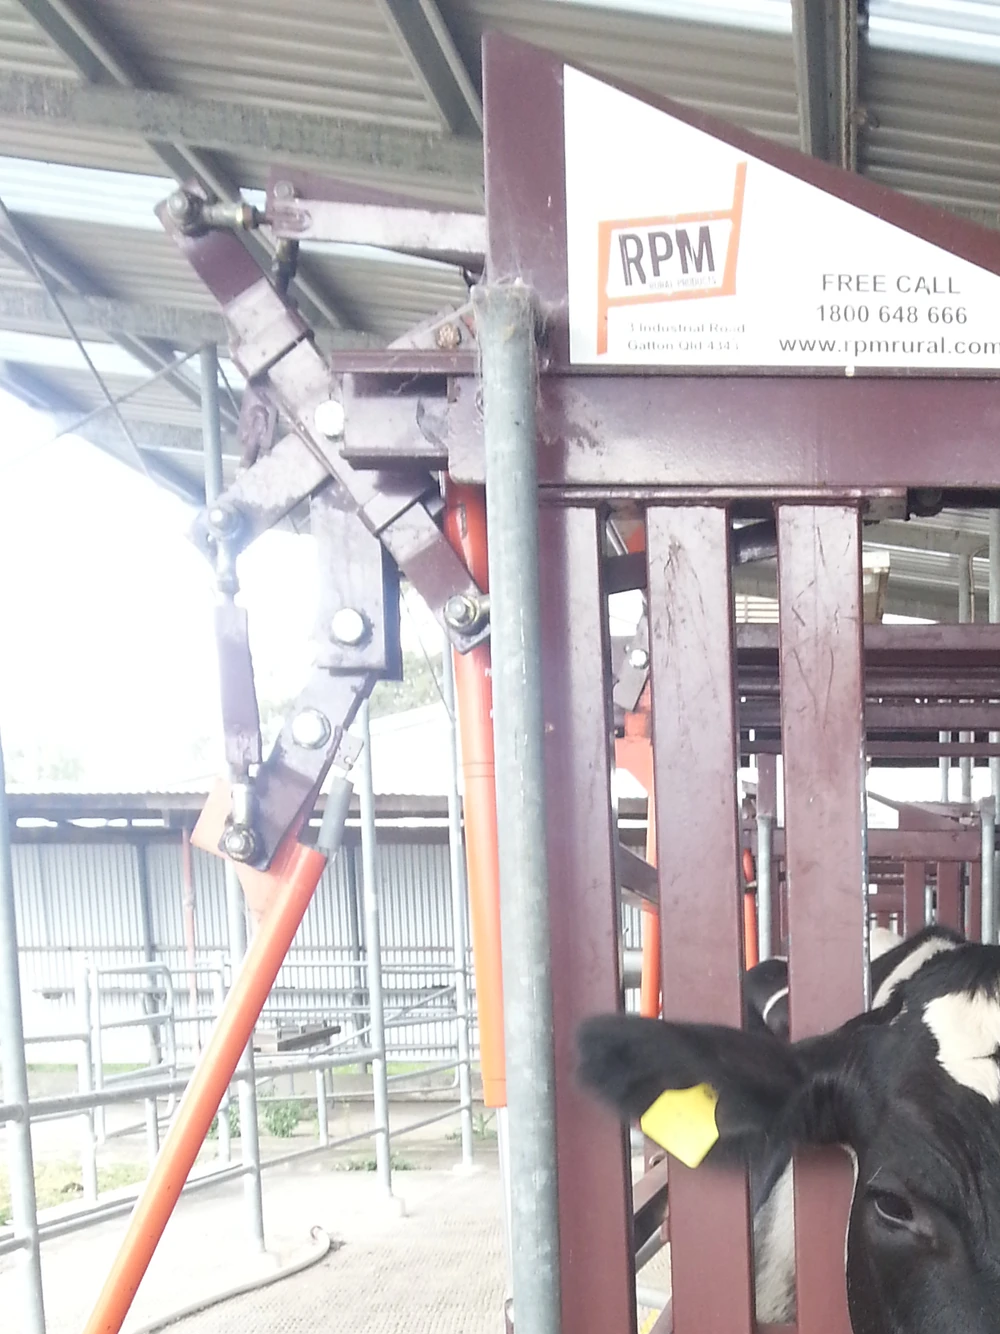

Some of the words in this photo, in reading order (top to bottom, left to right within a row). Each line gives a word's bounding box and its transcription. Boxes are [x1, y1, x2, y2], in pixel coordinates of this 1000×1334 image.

[618, 225, 715, 286] RPM
[822, 273, 886, 292] FREE
[896, 275, 961, 295] CALL
[816, 304, 869, 322] 1800
[879, 305, 918, 323] 648
[927, 306, 967, 324] 666
[627, 339, 674, 350] Gatton
